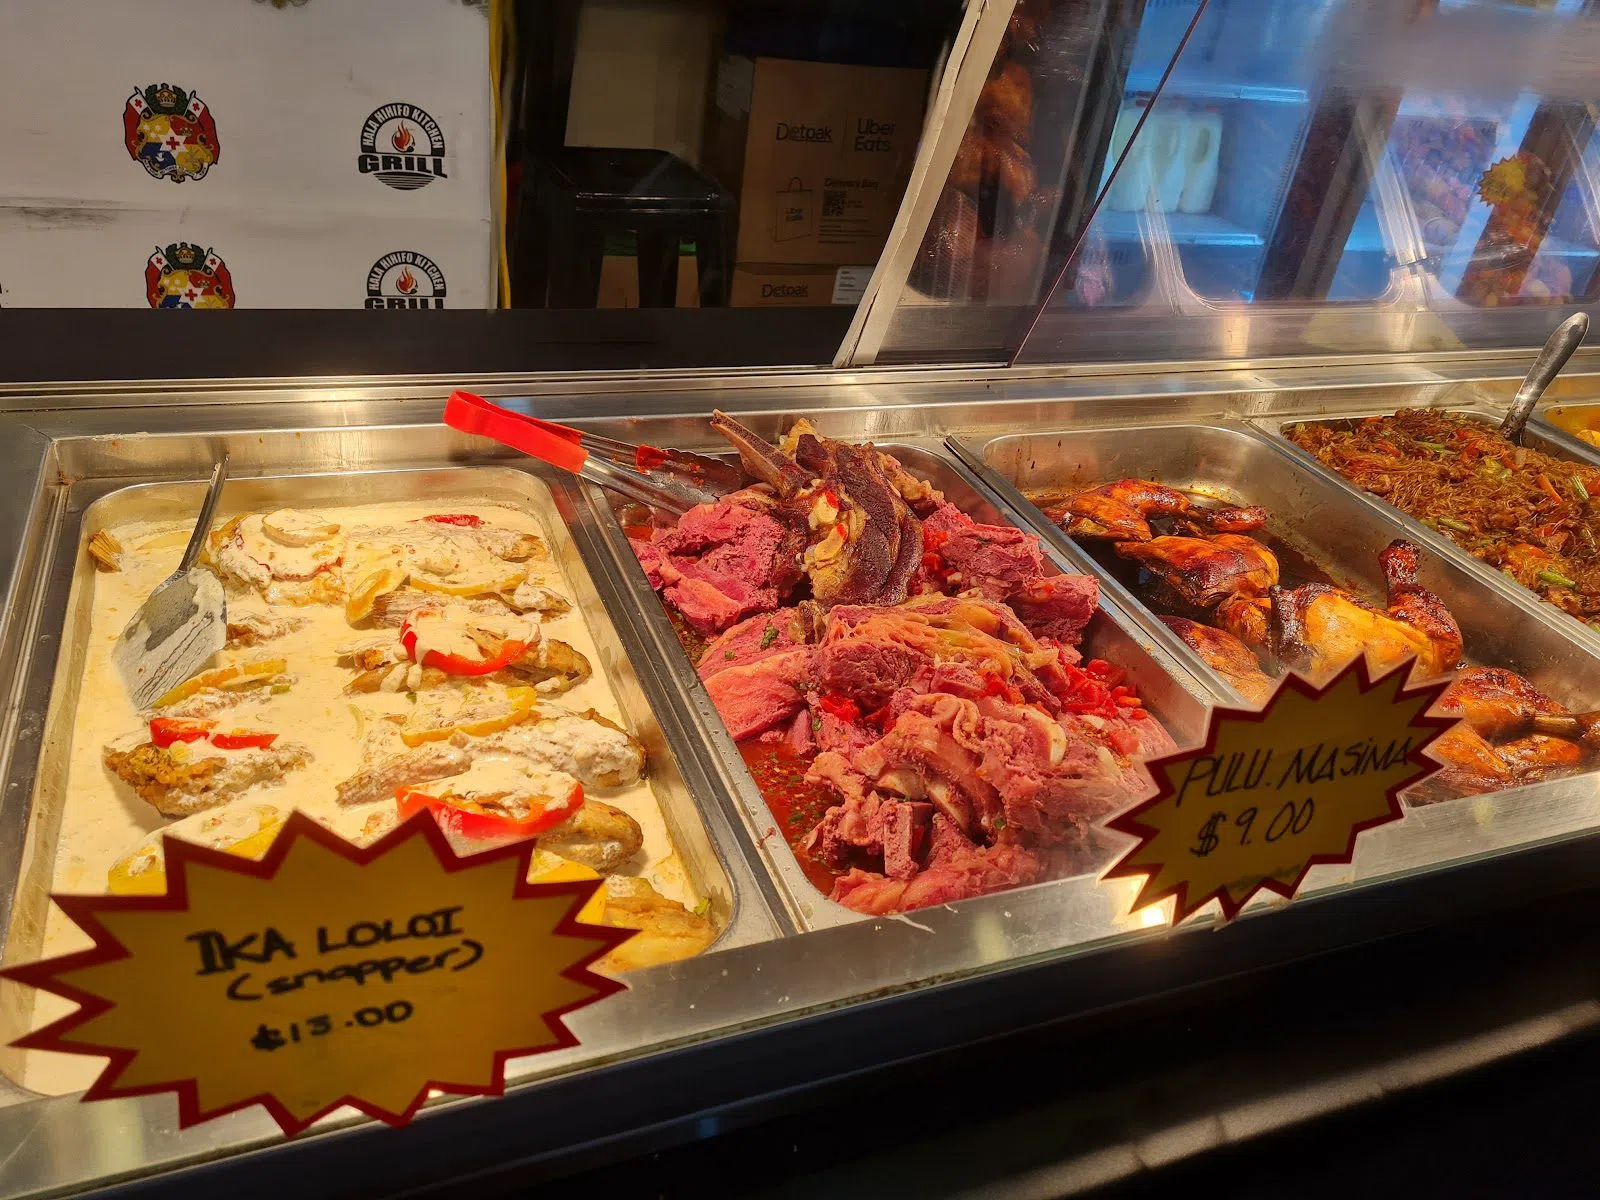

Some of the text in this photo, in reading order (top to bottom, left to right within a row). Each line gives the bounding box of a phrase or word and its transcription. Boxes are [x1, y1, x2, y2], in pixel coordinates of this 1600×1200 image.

[362, 104, 444, 149] HALA HIHIFO KITCHEN
[855, 136, 891, 152] Eats
[857, 118, 896, 135] Uber
[358, 154, 448, 179] GRILL
[368, 252, 445, 291] HALA HIHIFO KITCHEN
[184, 905, 465, 976] IKA LOLOI
[226, 938, 485, 1002] (snapper)
